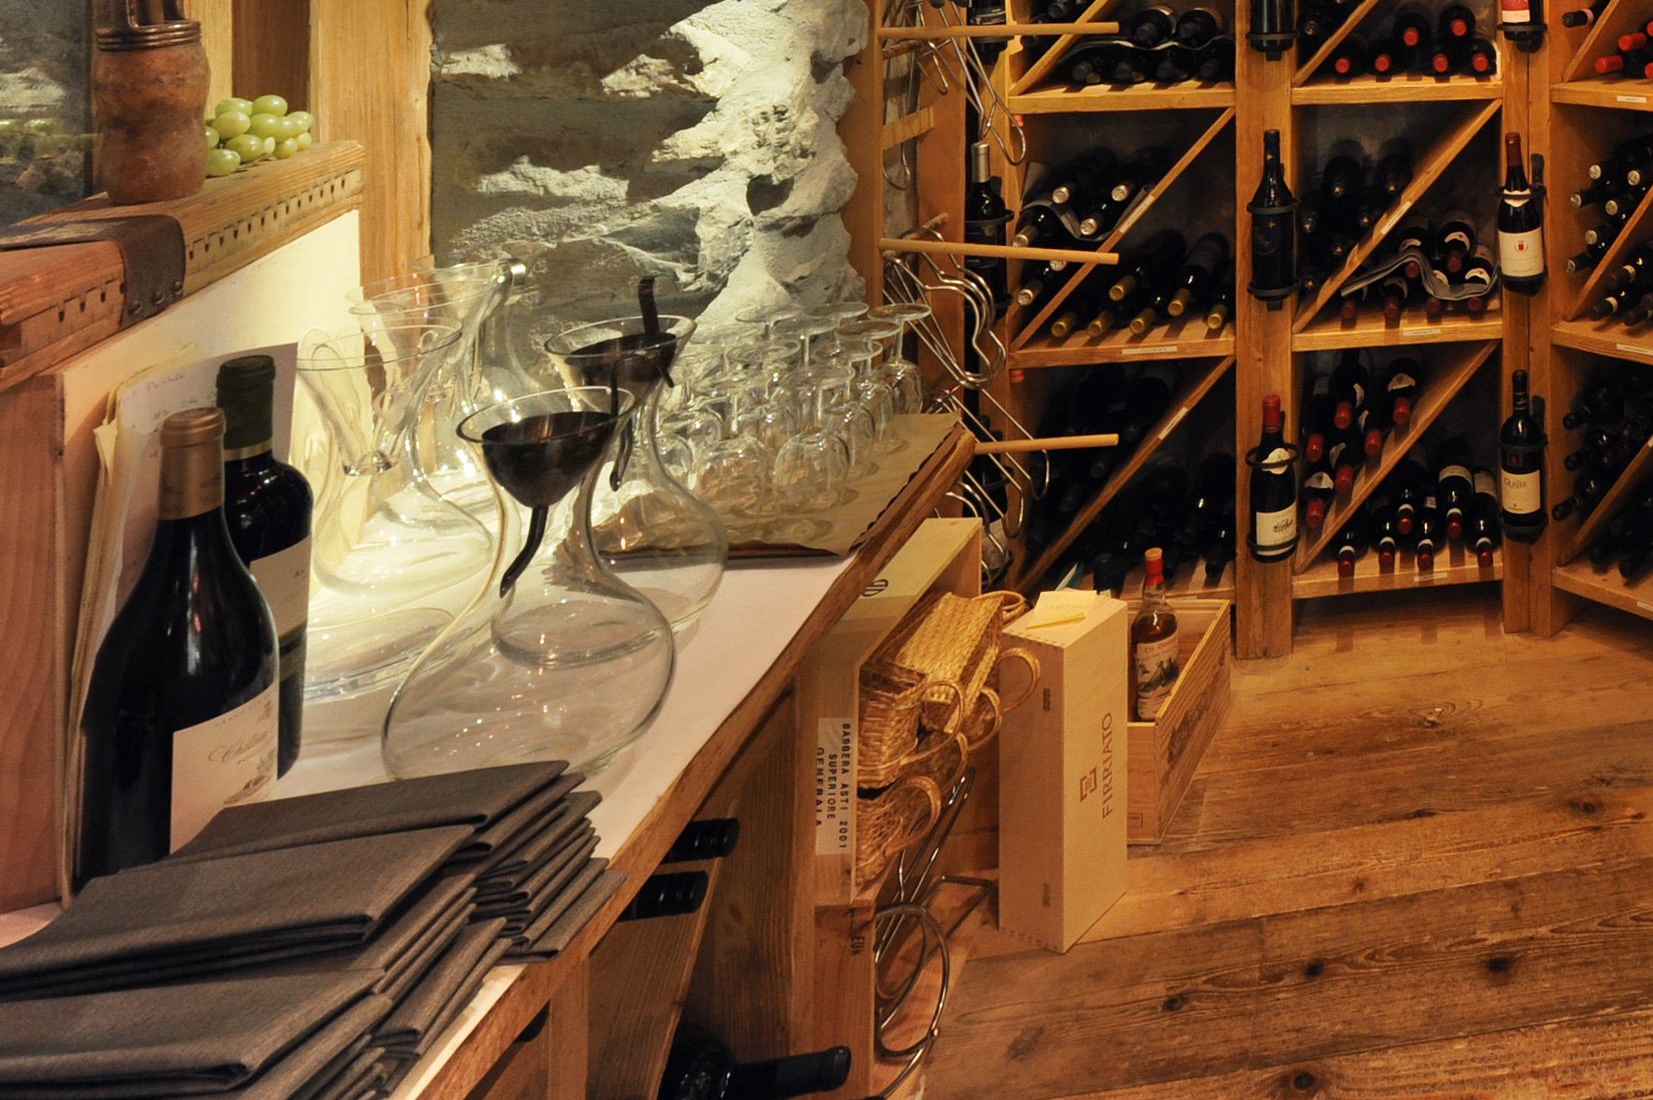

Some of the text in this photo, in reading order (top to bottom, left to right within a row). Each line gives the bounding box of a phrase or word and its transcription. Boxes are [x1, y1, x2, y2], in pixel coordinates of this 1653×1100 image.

[826, 753, 837, 820] SUPERIORE
[838, 722, 851, 849] BARBERA ASTI 2001
[1101, 712, 1113, 820] FIRRIATO
